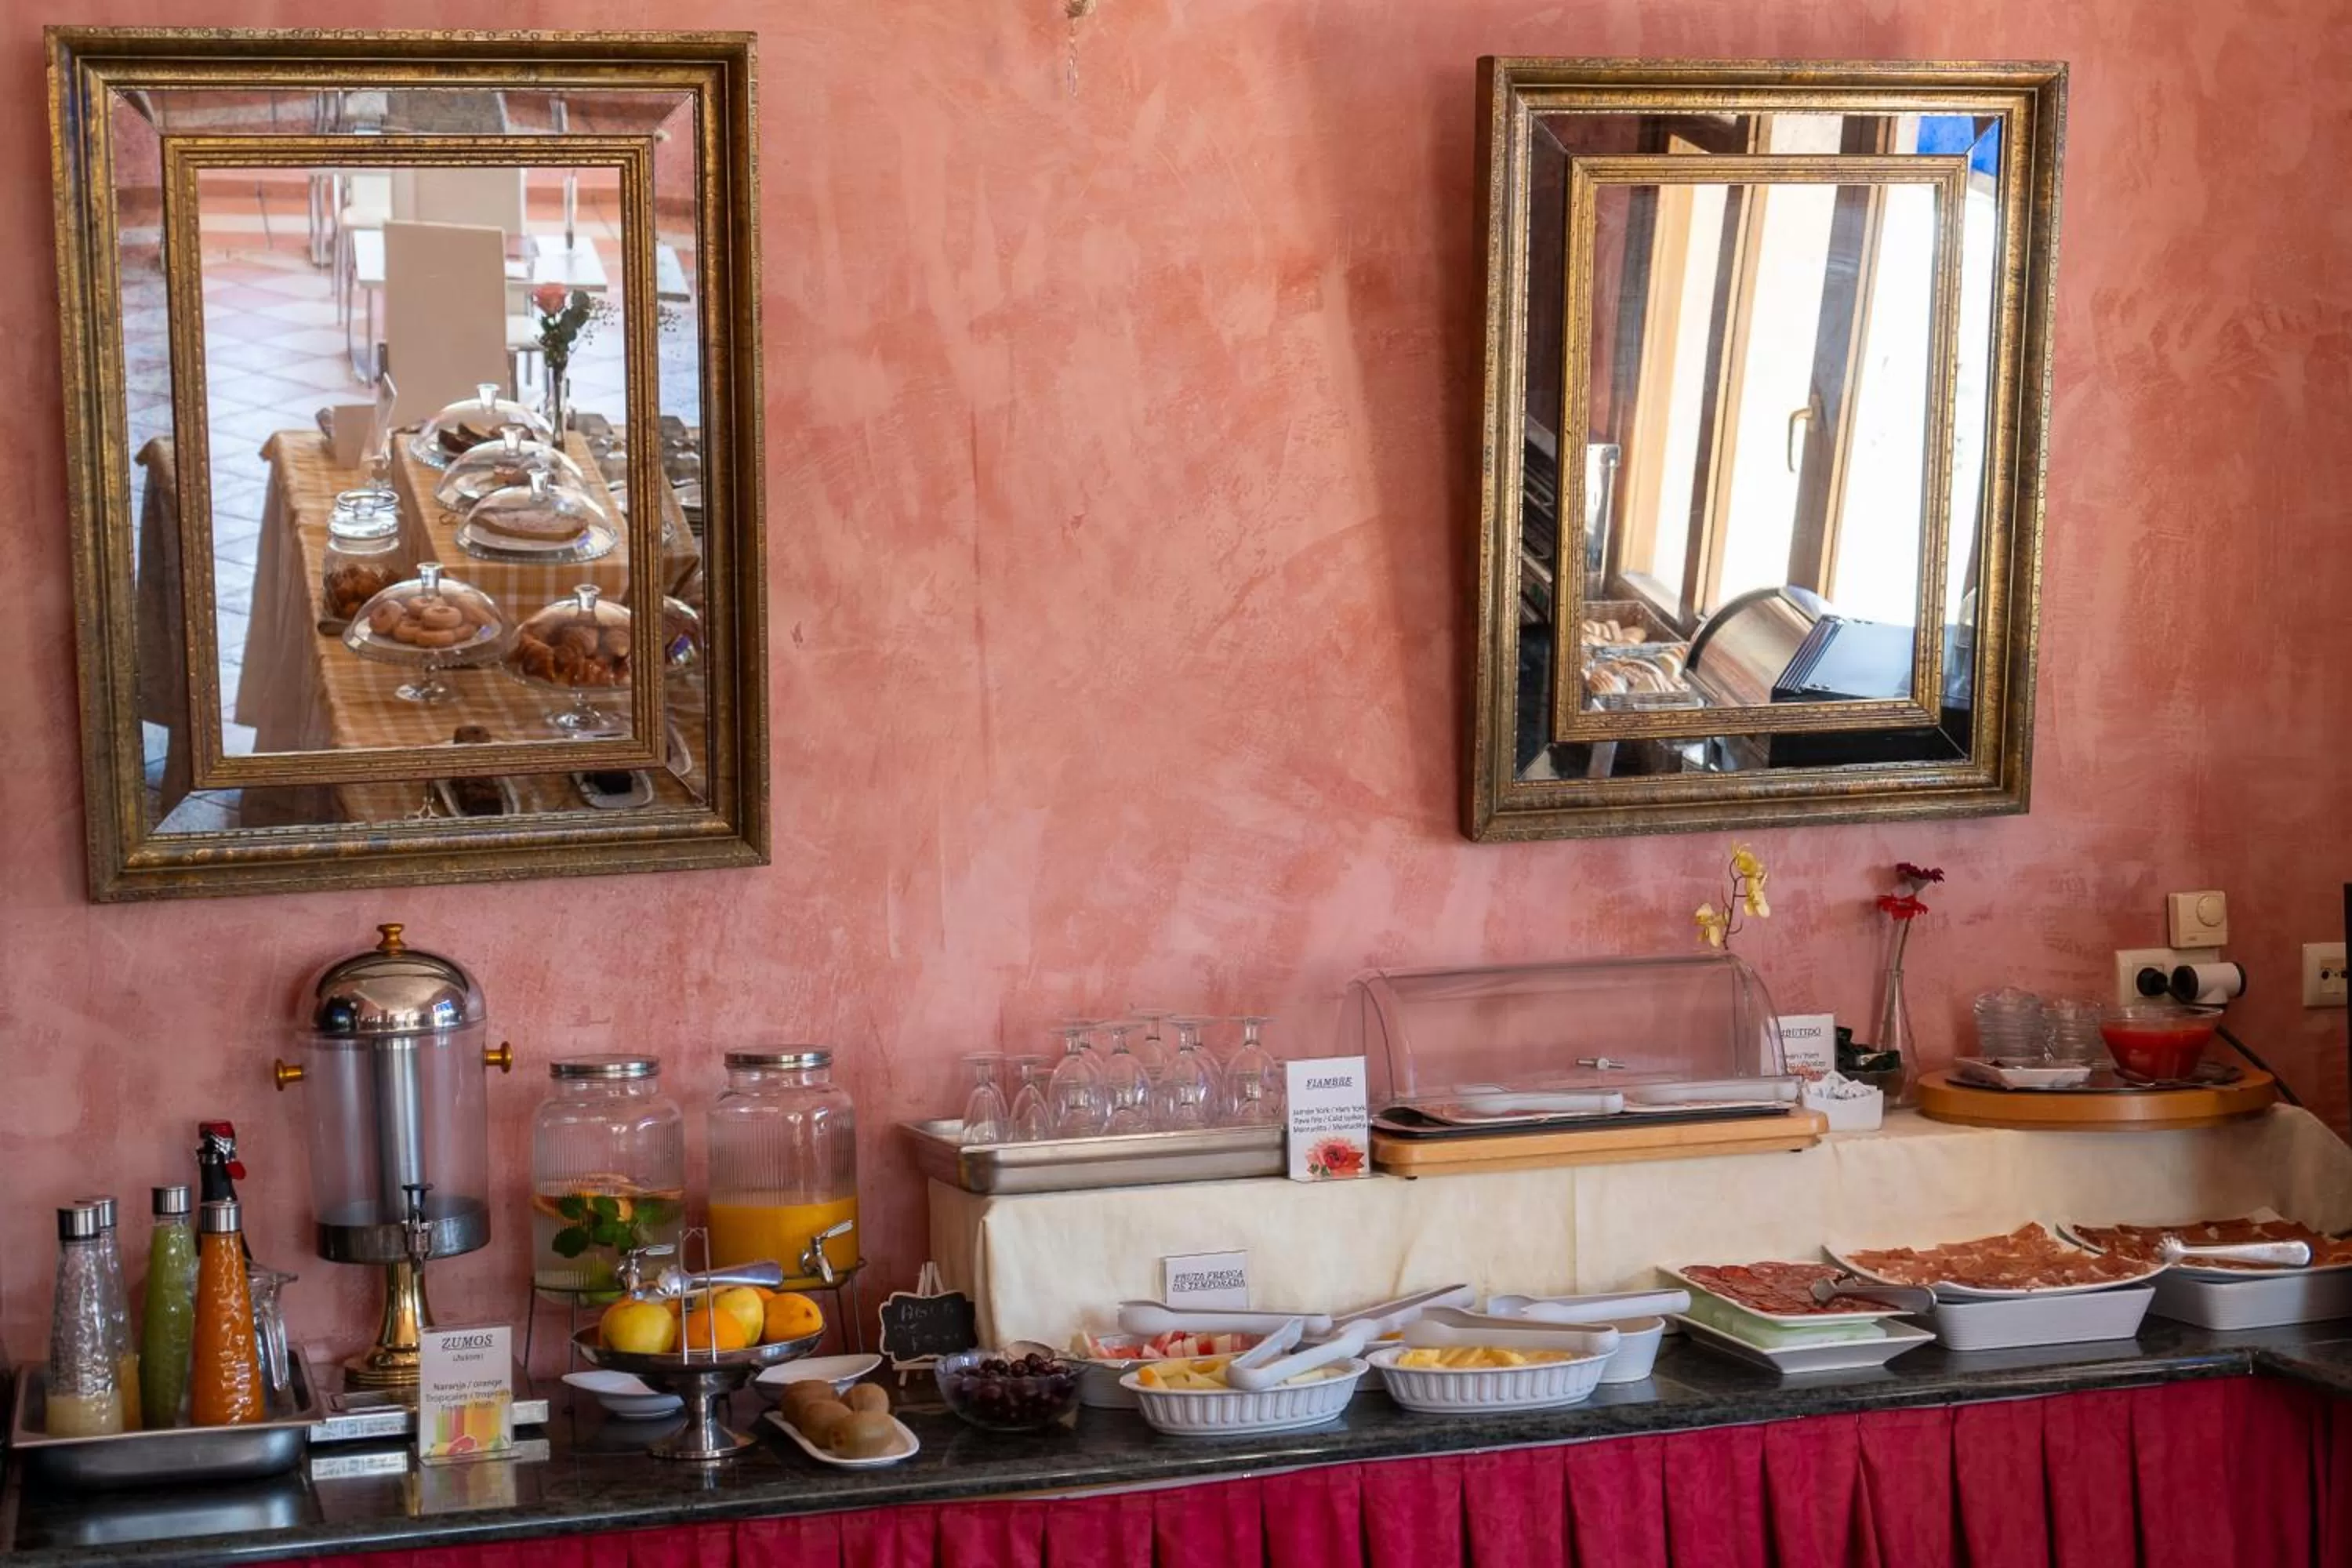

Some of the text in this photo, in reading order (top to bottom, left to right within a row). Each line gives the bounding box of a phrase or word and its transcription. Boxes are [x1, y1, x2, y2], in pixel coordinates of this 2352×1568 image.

[1306, 1076, 1352, 1088] FIAMBRE
[1174, 1269, 1243, 1281] FRUTA FRESCA
[1189, 1279, 1246, 1290] TEMPORADA
[442, 1334, 494, 1349] ZUMOS
